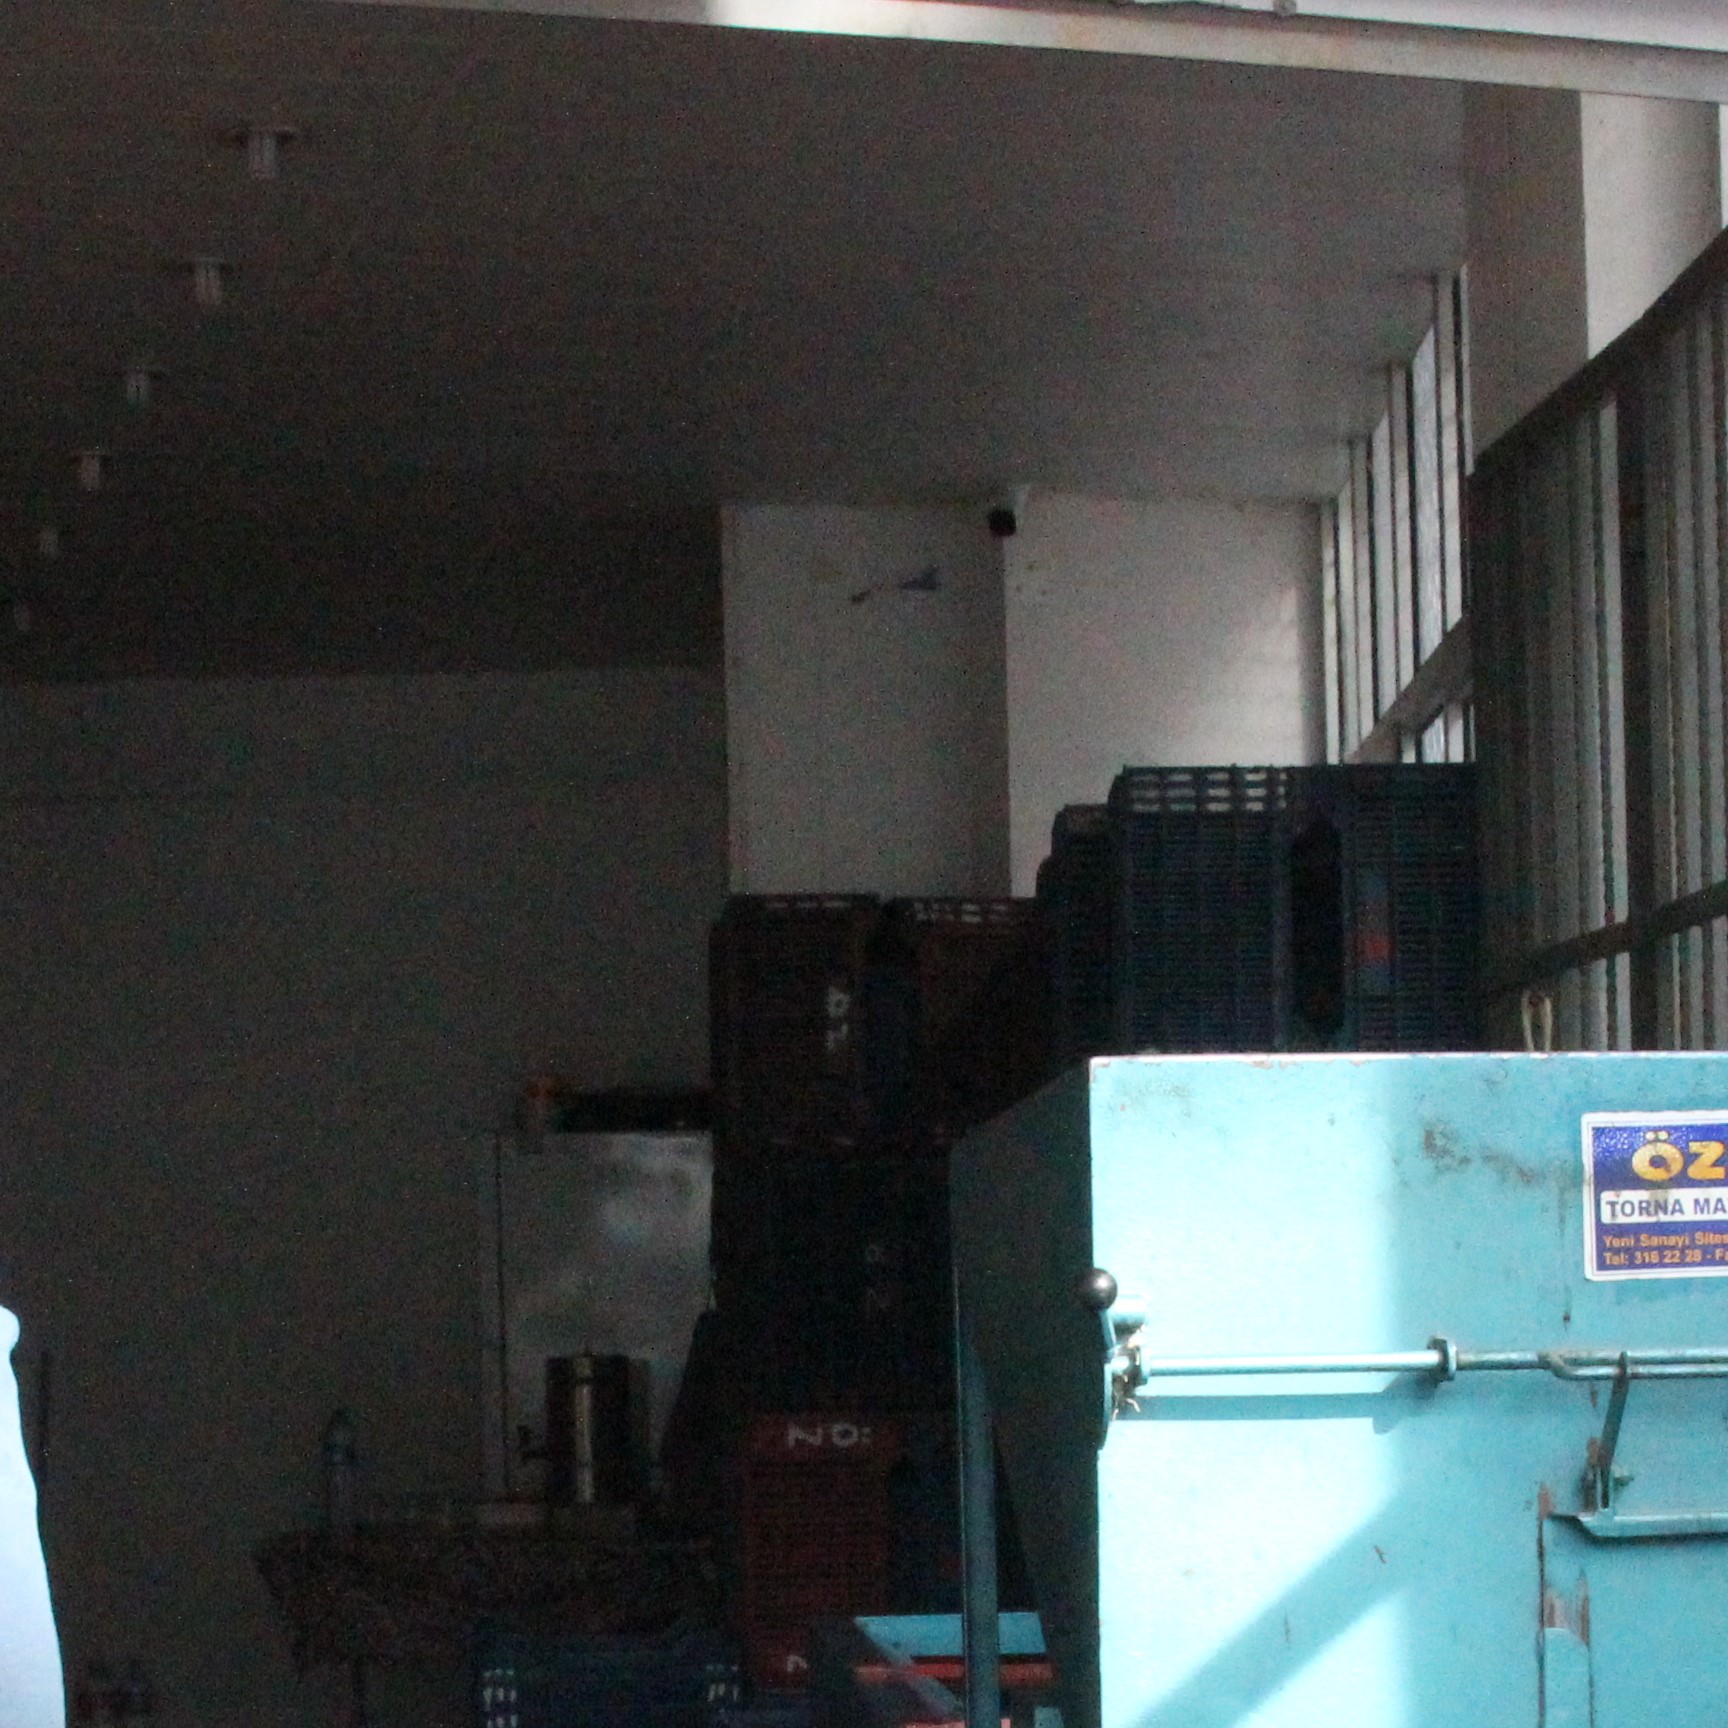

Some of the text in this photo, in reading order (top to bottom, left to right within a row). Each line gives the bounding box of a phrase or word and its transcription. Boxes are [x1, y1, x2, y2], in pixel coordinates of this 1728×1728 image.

[1605, 1198, 1685, 1218] TORNA
[1603, 1235, 1634, 1247] Yeni
[1640, 1233, 1689, 1248] Sanayi
[1603, 1252, 1629, 1265] Tel:
[1663, 1250, 1681, 1263] 22
